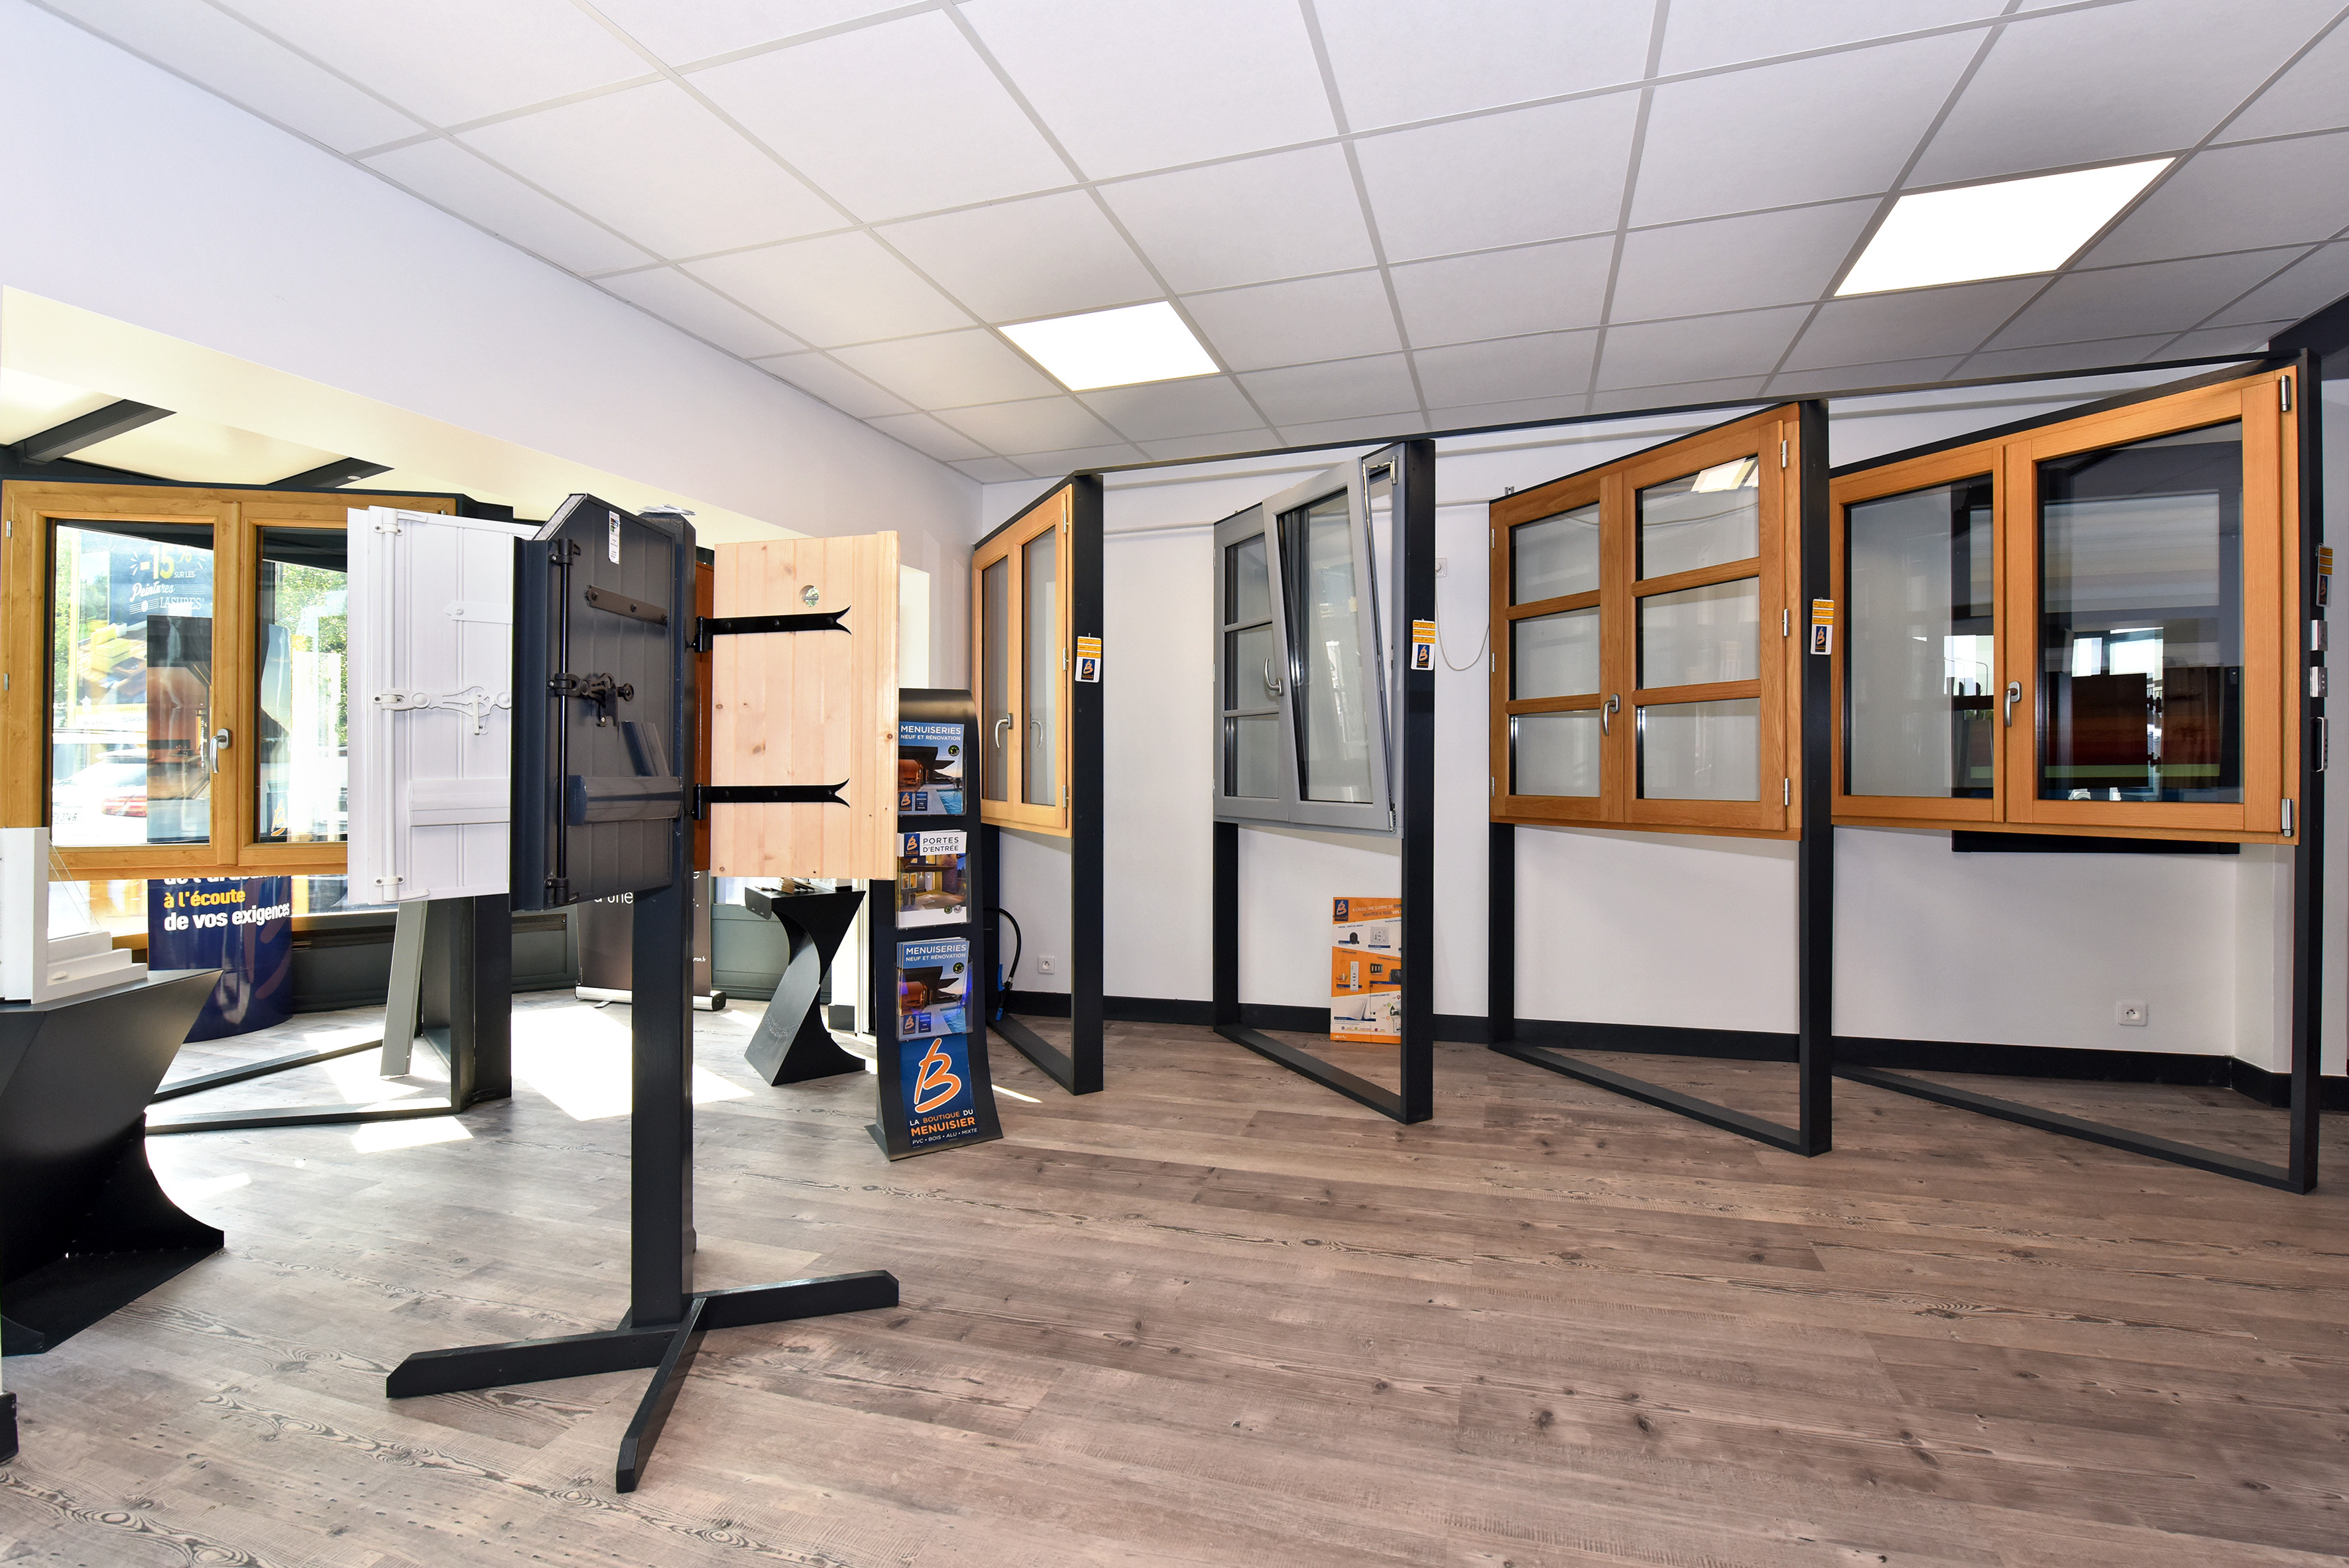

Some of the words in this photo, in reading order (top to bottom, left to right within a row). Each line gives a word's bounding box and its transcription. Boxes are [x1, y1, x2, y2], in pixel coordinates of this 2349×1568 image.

[129, 581, 176, 603] Peintures
[900, 725, 961, 735] MENUISERIES
[163, 892, 175, 909] à
[178, 888, 246, 908] l'écoute
[164, 912, 189, 932] de
[192, 912, 228, 929] vos
[231, 902, 290, 926] exigences
[906, 944, 967, 955] MENUISERIES
[911, 1116, 975, 1137] MENUISIER
[923, 1111, 960, 1124] BOUTIQUE
